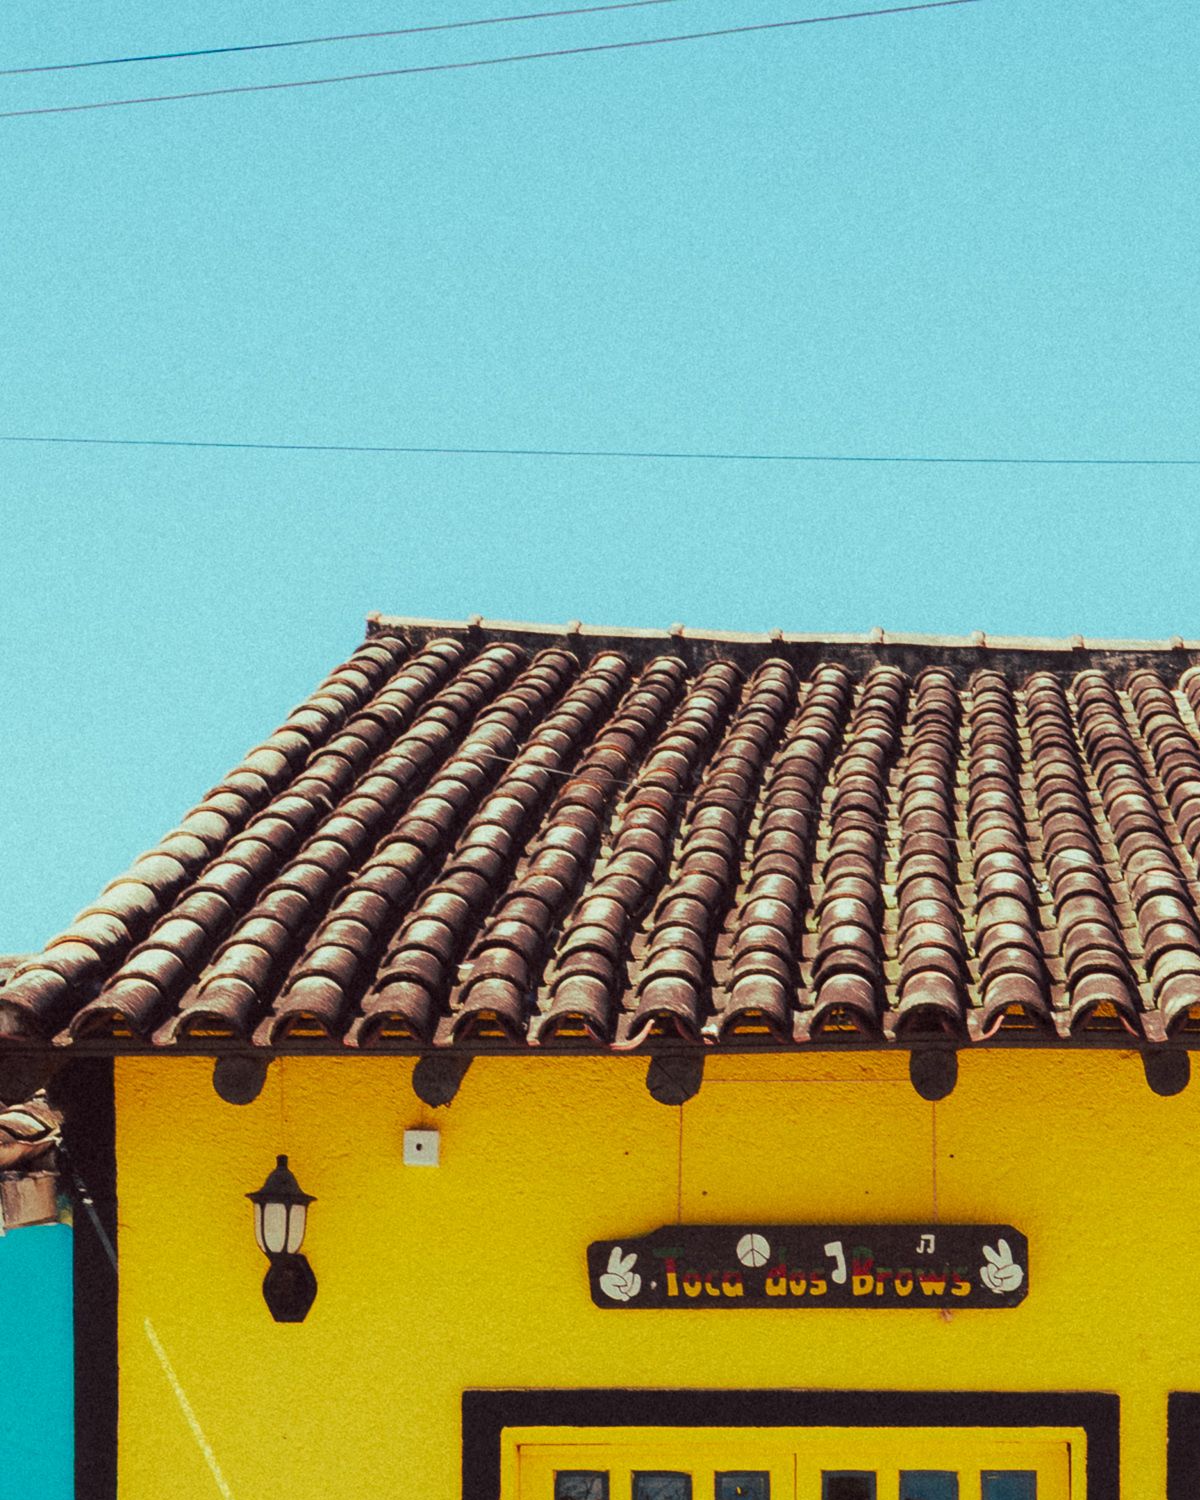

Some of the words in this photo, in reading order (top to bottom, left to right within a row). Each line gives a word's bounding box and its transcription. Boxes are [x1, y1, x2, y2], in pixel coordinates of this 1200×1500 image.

[652, 1247, 744, 1297] Toca
[765, 1248, 828, 1297] dos
[851, 1246, 972, 1297] Brows
